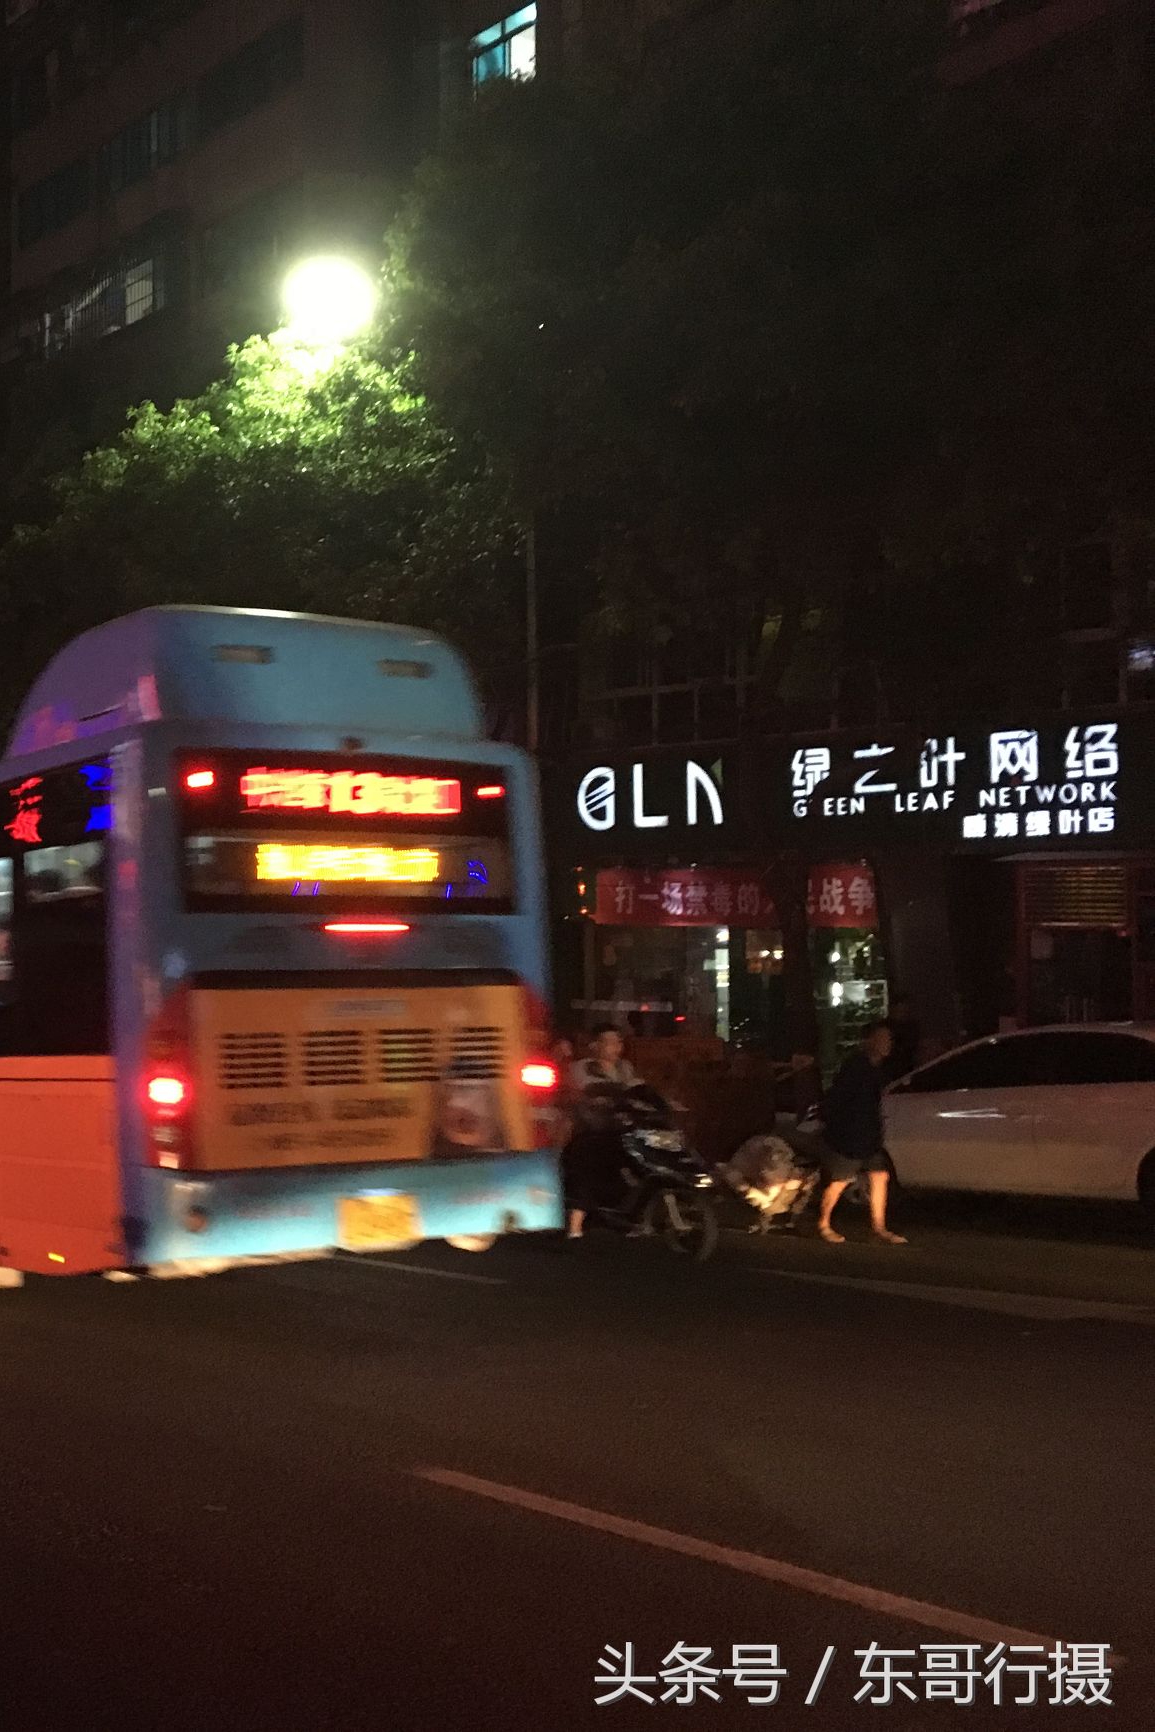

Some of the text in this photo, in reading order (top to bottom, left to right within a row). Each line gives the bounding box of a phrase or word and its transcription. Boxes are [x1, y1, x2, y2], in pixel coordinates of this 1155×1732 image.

[793, 781, 1118, 818] GEEN LEAF NETWORK
[614, 876, 875, 916] 打一场禁毒的战争
